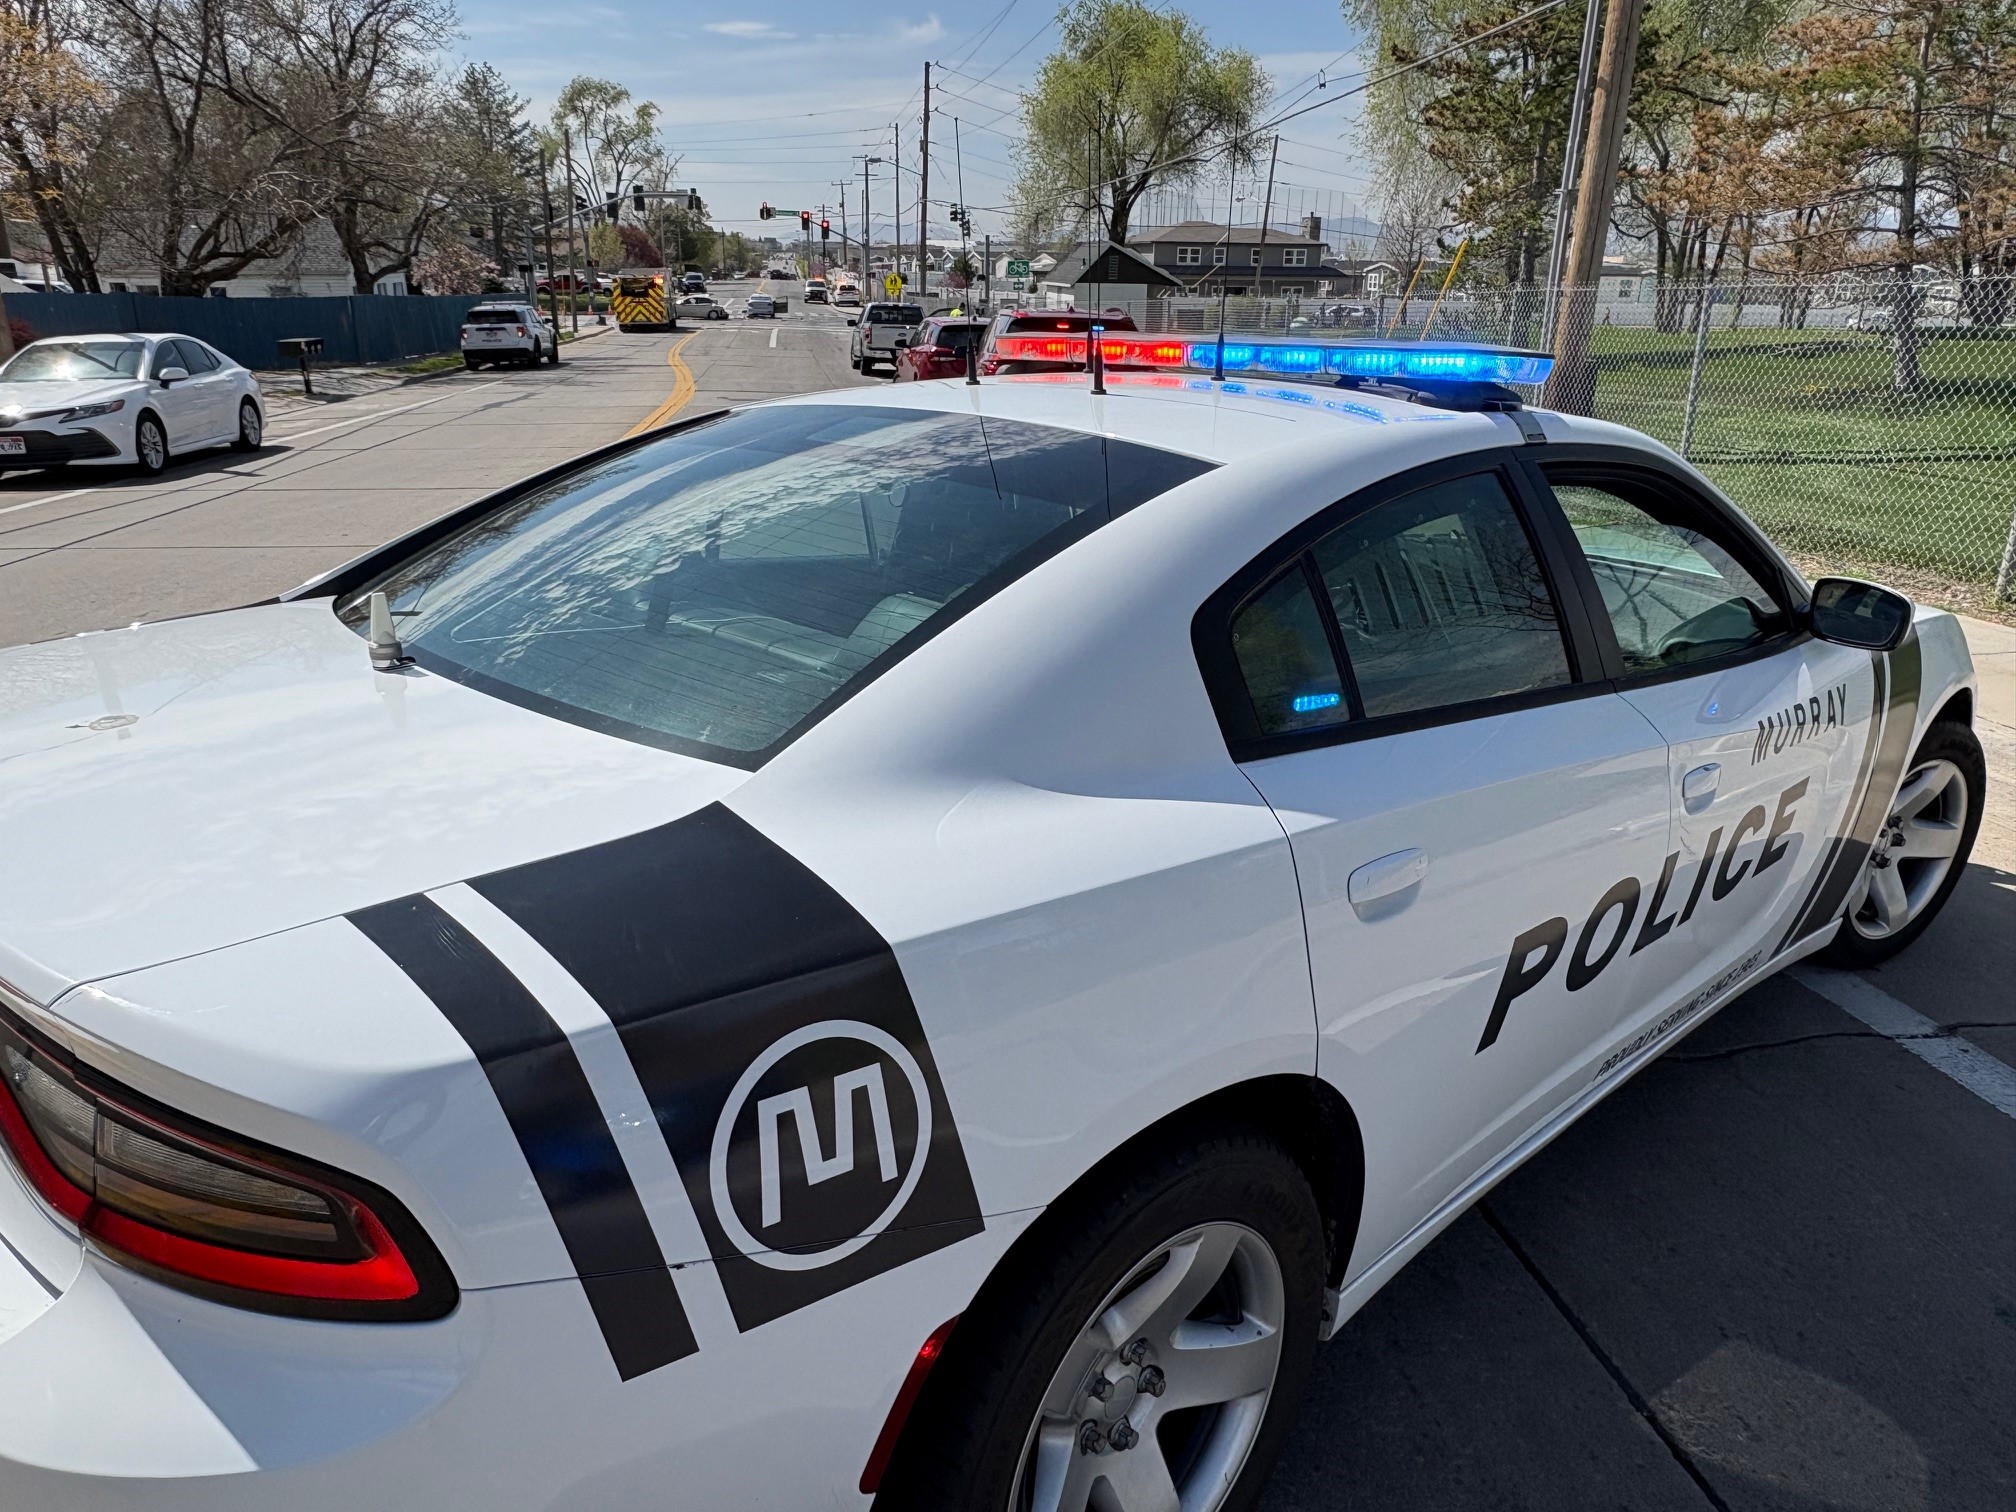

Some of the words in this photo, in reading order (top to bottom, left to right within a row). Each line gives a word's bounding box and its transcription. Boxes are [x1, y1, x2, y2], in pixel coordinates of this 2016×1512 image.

[1750, 682, 1847, 766] MURRAY
[1474, 775, 1811, 1055] POLICE
[757, 1061, 899, 1229] M
